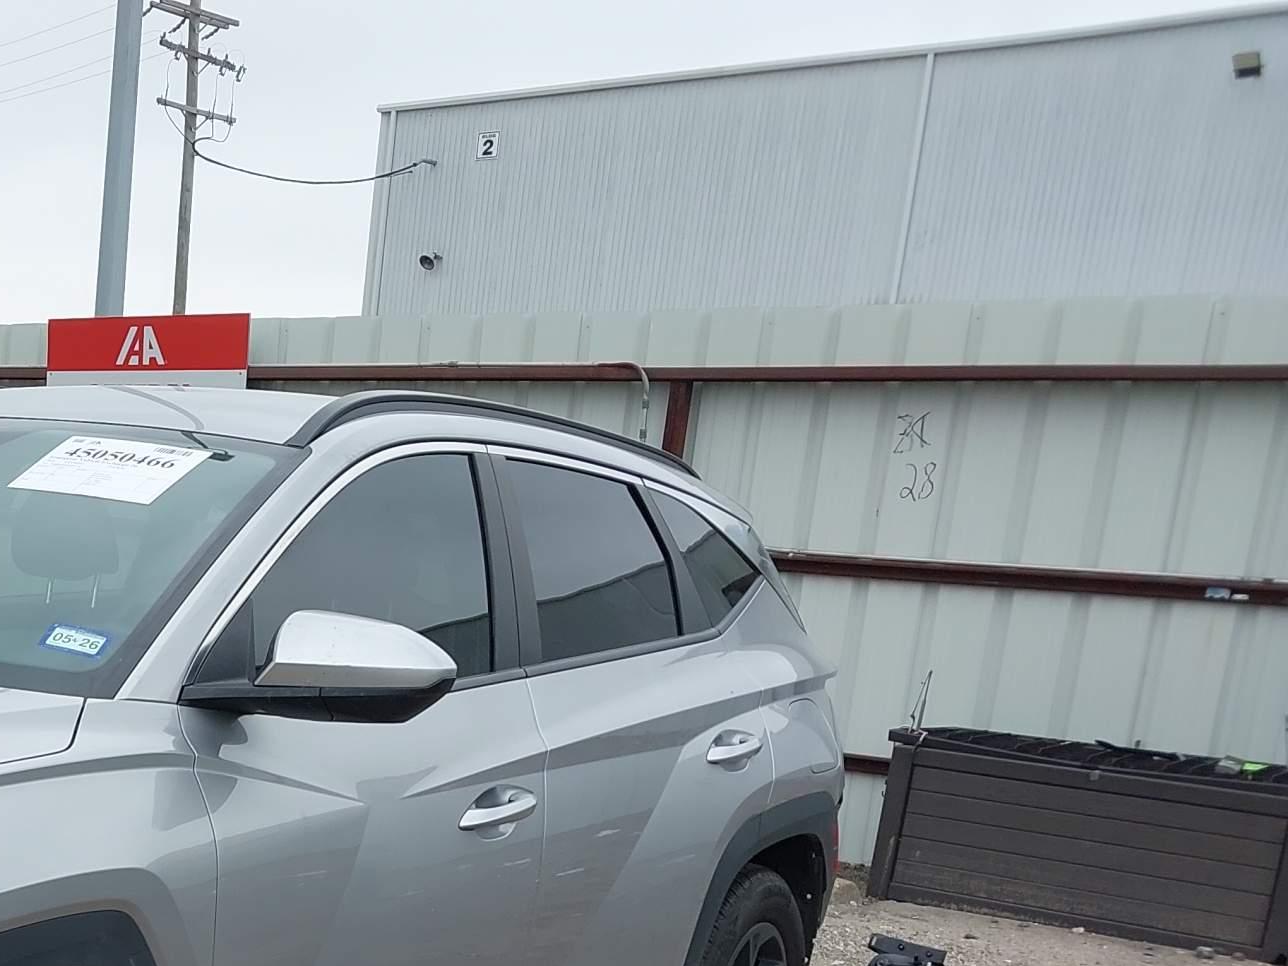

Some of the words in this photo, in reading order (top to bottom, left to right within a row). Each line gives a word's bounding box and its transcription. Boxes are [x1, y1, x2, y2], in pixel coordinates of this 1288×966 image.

[481, 139, 494, 156] 2
[64, 447, 175, 469] 45050466
[899, 461, 937, 502] 28
[52, 632, 74, 644] 05
[78, 638, 101, 650] 26
